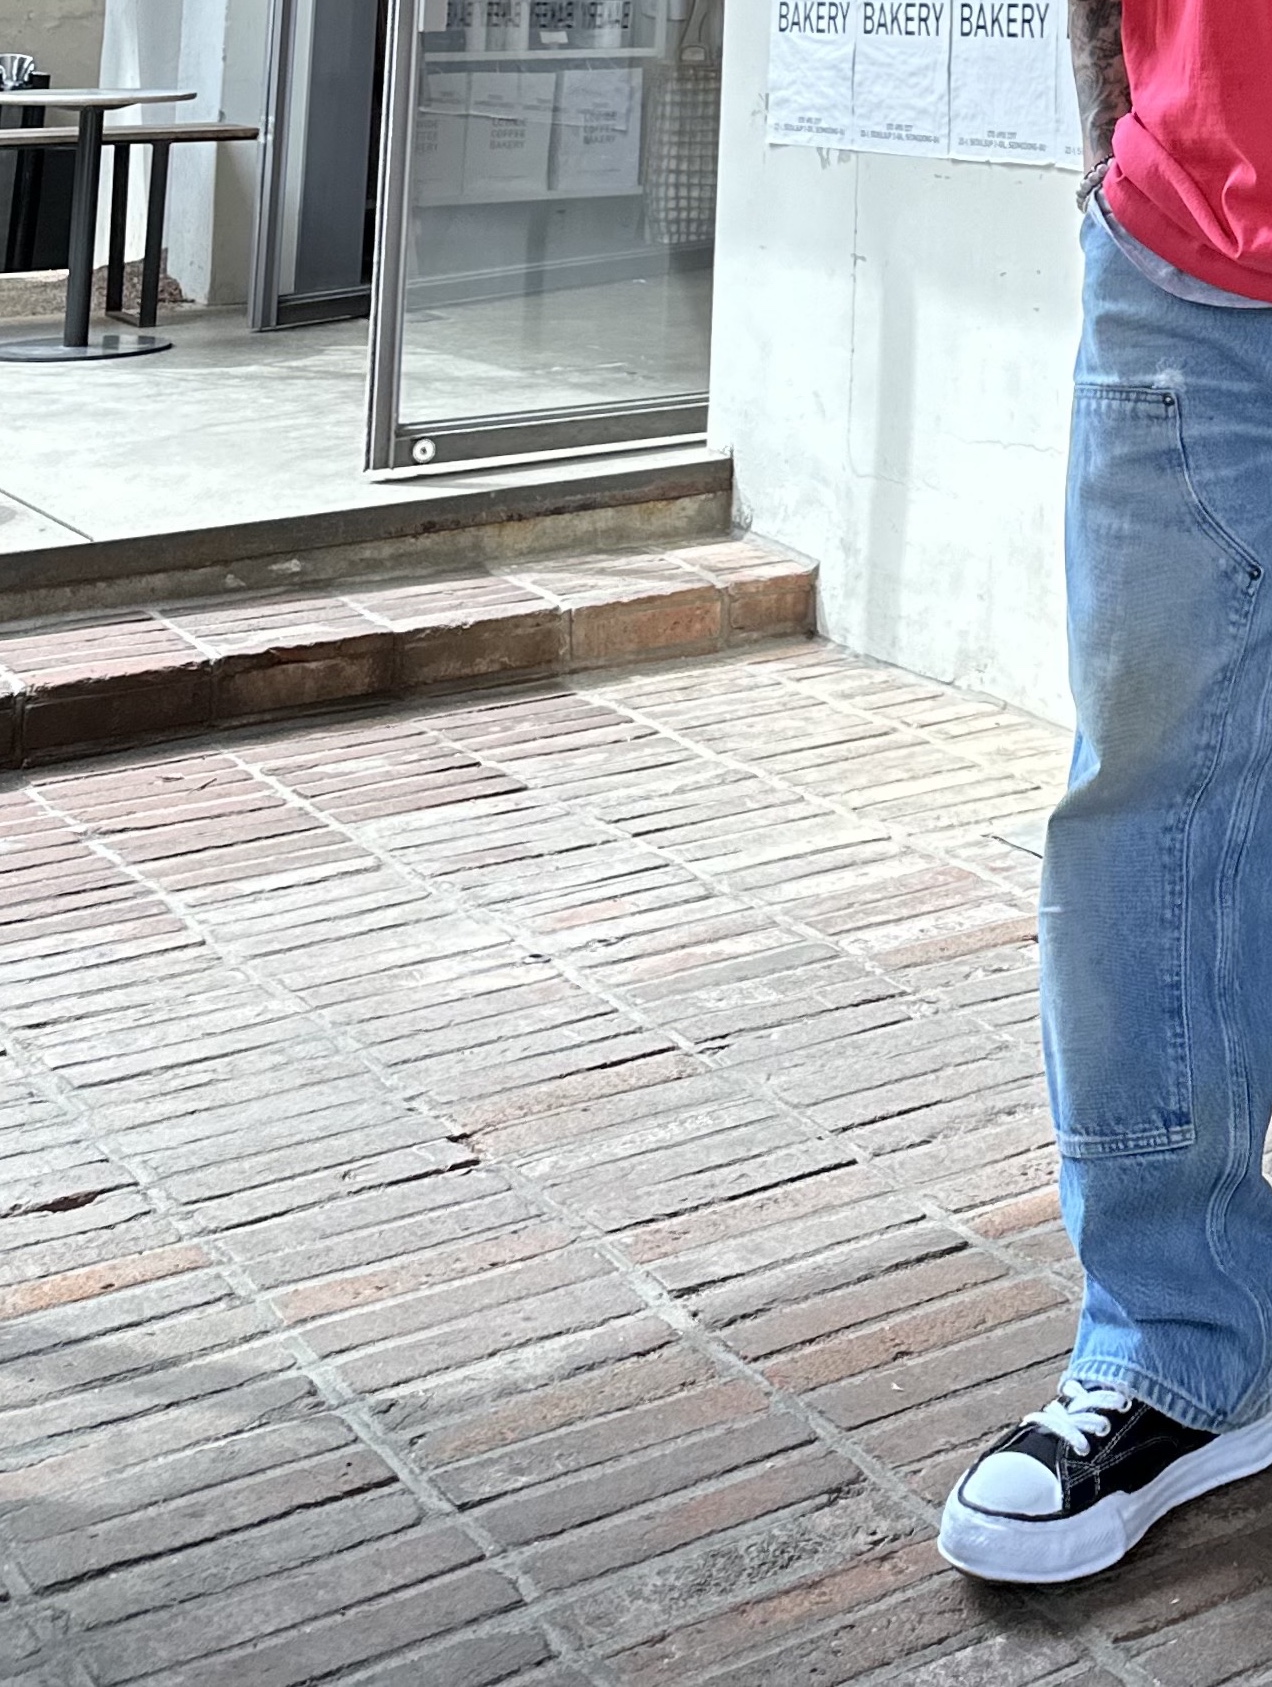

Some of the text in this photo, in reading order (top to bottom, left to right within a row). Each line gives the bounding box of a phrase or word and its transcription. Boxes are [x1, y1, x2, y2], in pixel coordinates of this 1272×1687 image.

[778, 1, 851, 34] BAKERY
[863, 1, 945, 37] BAKERY
[960, 2, 1050, 39] BAKERY
